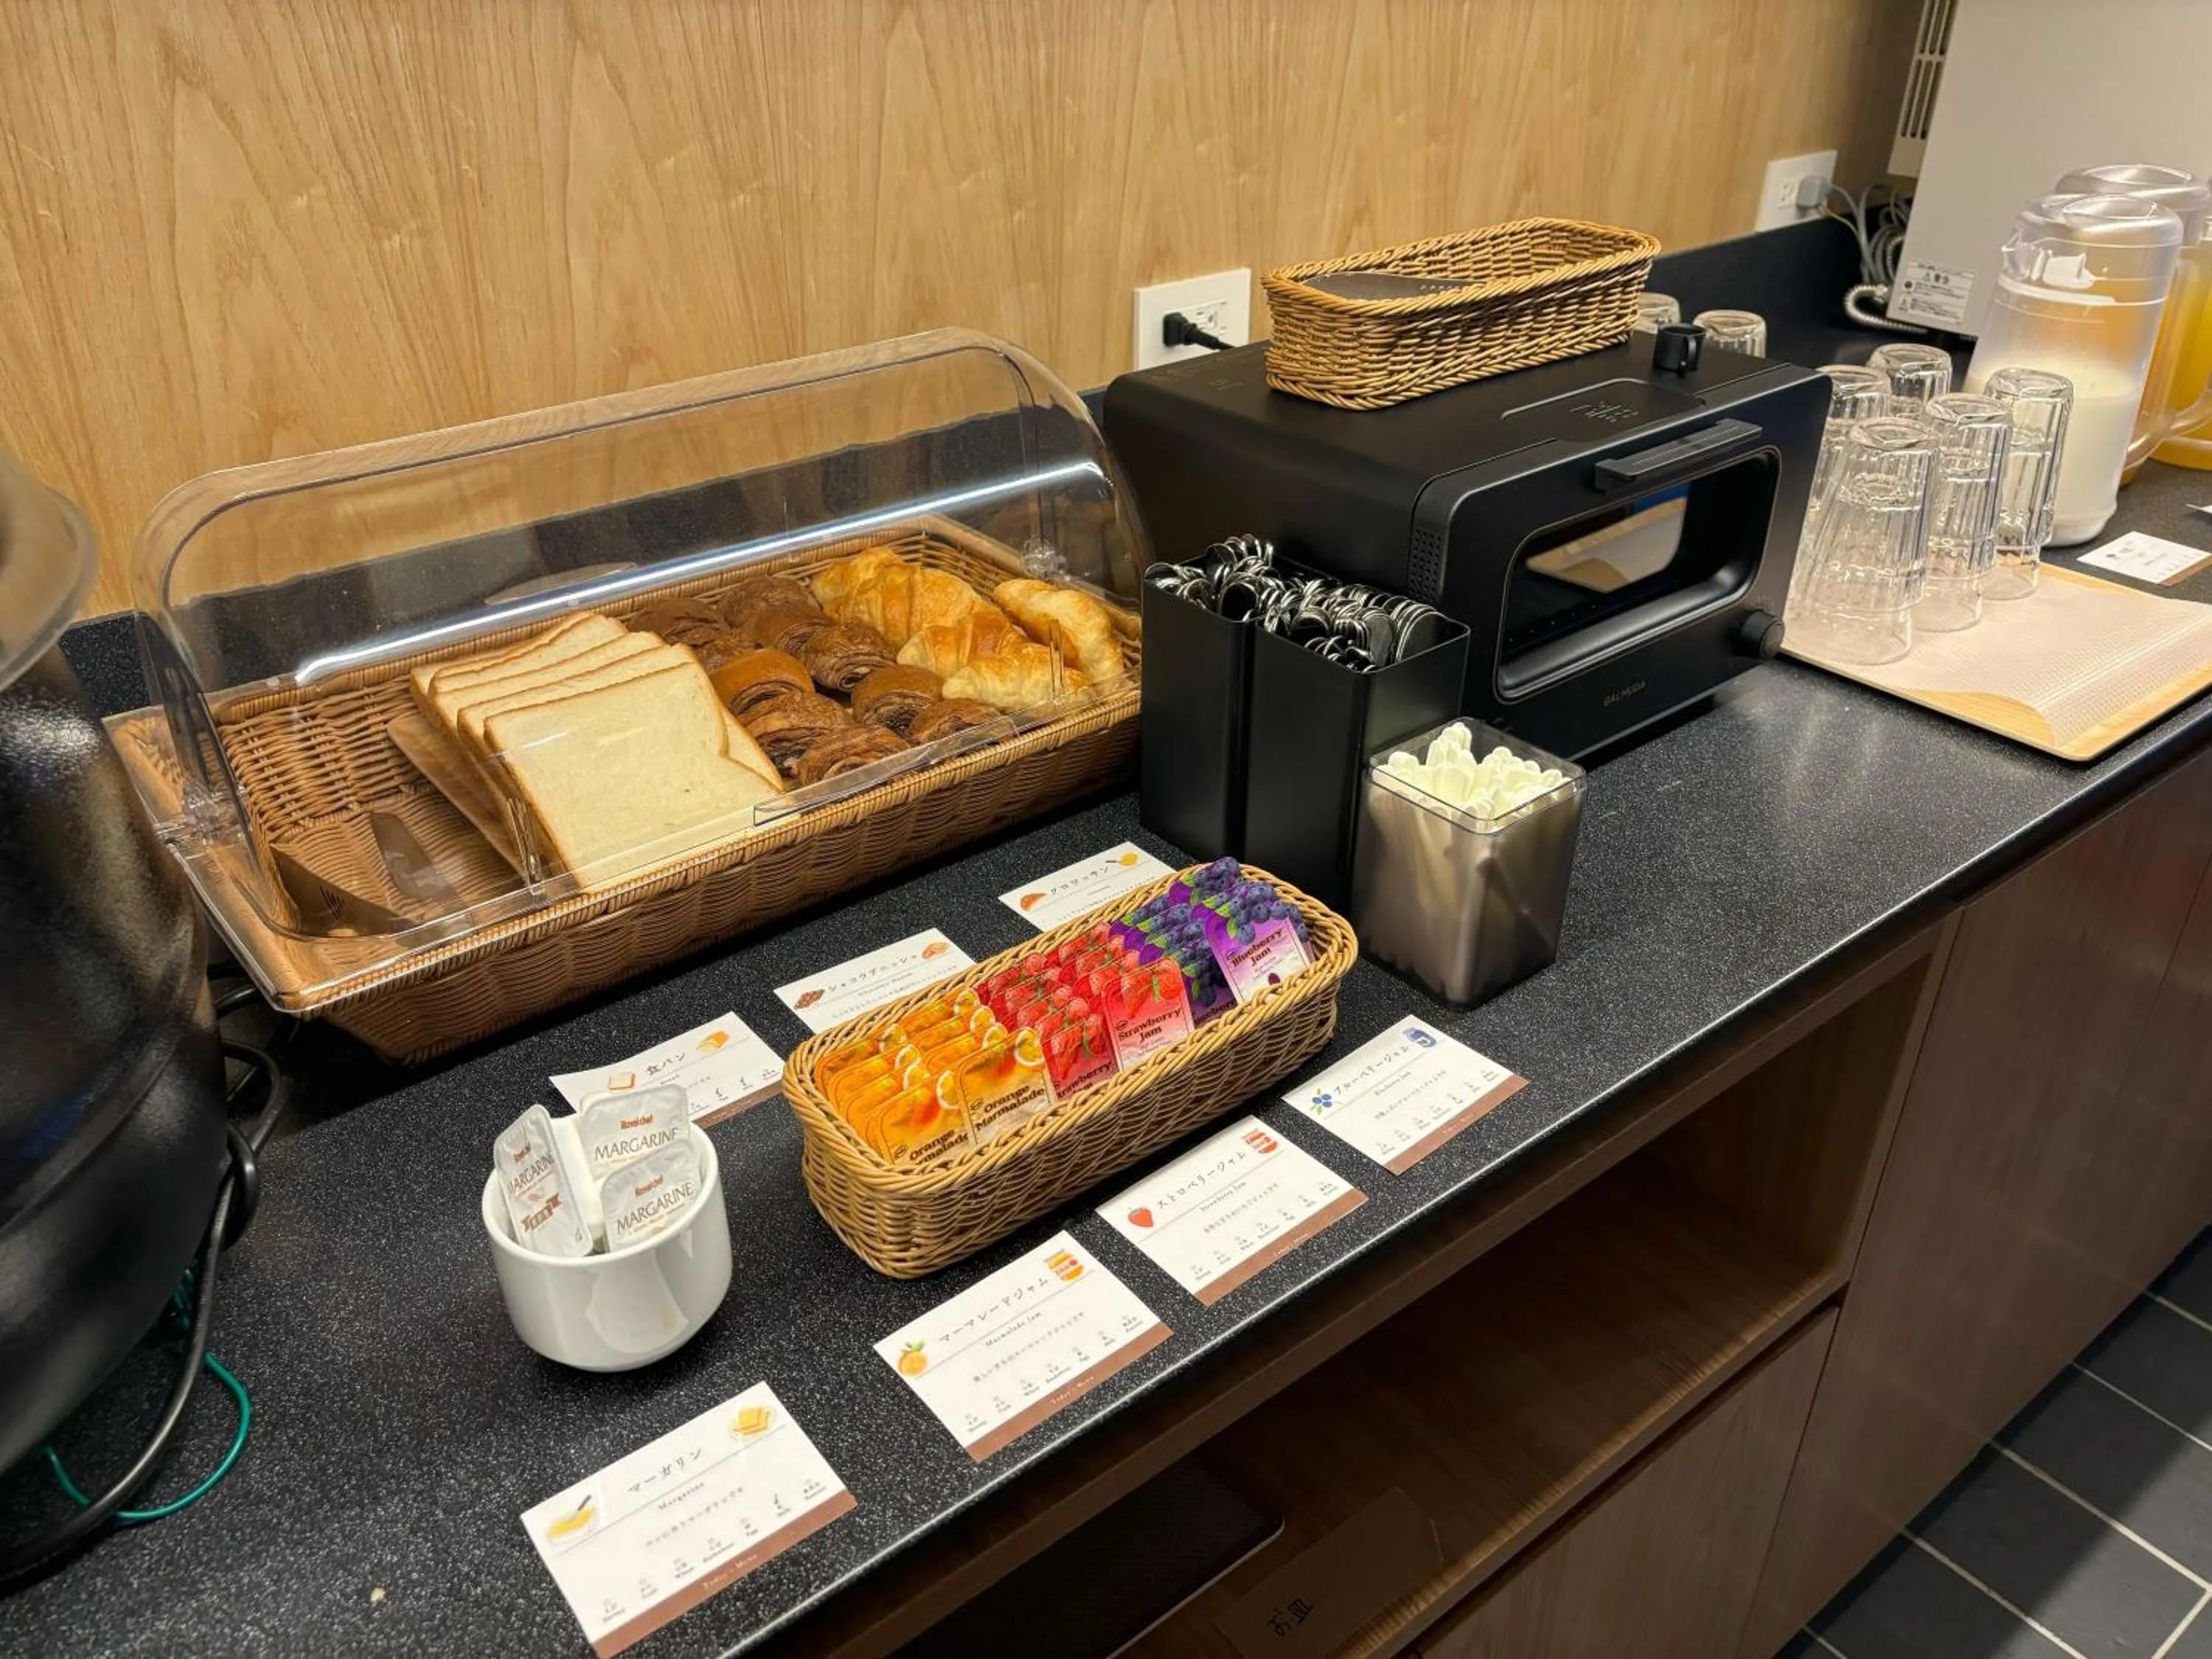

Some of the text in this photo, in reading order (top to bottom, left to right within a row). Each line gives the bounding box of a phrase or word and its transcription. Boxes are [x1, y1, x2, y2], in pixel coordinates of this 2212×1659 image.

[1231, 928, 1283, 967] Blueberry
[1250, 947, 1272, 967] Jam
[1118, 1004, 1184, 1040] Strawberry
[1139, 1026, 1163, 1043] Jam
[647, 1052, 685, 1077] 食パン
[975, 1088, 1045, 1132] Marmalade
[983, 1085, 1030, 1113] Orange
[909, 1130, 955, 1161] Orange
[1156, 1151, 1248, 1209] ストロベリージャム
[617, 1181, 693, 1235] MARGARINE
[939, 1278, 1048, 1343] マーマレードジャム
[627, 1448, 703, 1494] マーガリン
[1265, 1596, 1315, 1638] お皿
